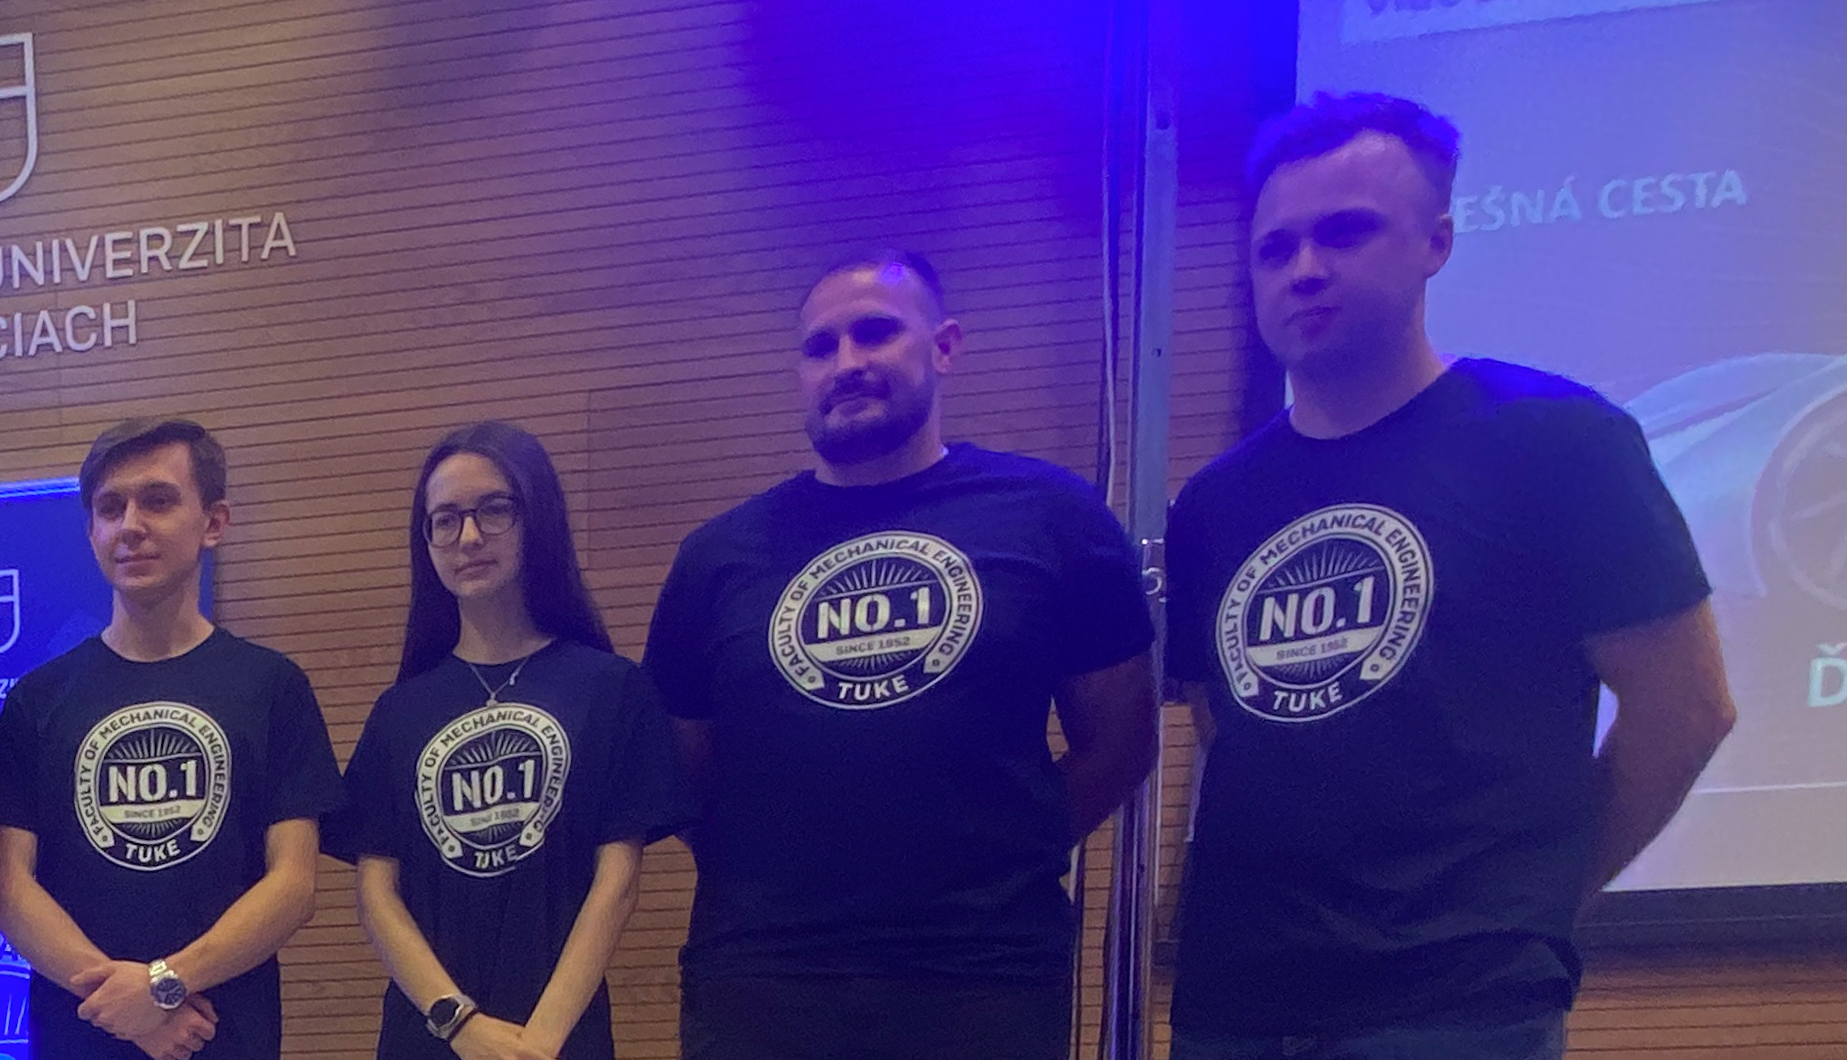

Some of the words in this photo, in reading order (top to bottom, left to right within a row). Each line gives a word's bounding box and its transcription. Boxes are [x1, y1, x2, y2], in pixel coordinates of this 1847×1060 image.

[1598, 169, 1747, 219] CESTA
[809, 538, 930, 579] MECHANICAL
[790, 580, 810, 601] OF
[932, 550, 972, 656] ENGINEERING
[1237, 568, 1256, 593] OF
[1260, 513, 1383, 565] MECHANICAL
[1380, 528, 1421, 660] ENGINEERING
[1259, 576, 1374, 641] NO.1
[817, 587, 930, 639] NO.1
[776, 606, 809, 677] FACULTY
[839, 674, 908, 700] TUKE
[1273, 681, 1343, 712] TUKE
[99, 709, 196, 739] MECHANICAL
[425, 748, 440, 768] OF
[440, 710, 541, 747] MECHANICAL
[85, 740, 100, 760] OF
[80, 766, 104, 836] FACULTY
[109, 760, 196, 802] NO.1
[198, 725, 226, 828] ENGINEERING
[452, 759, 534, 811] NO.1
[126, 839, 180, 862] TUKE
